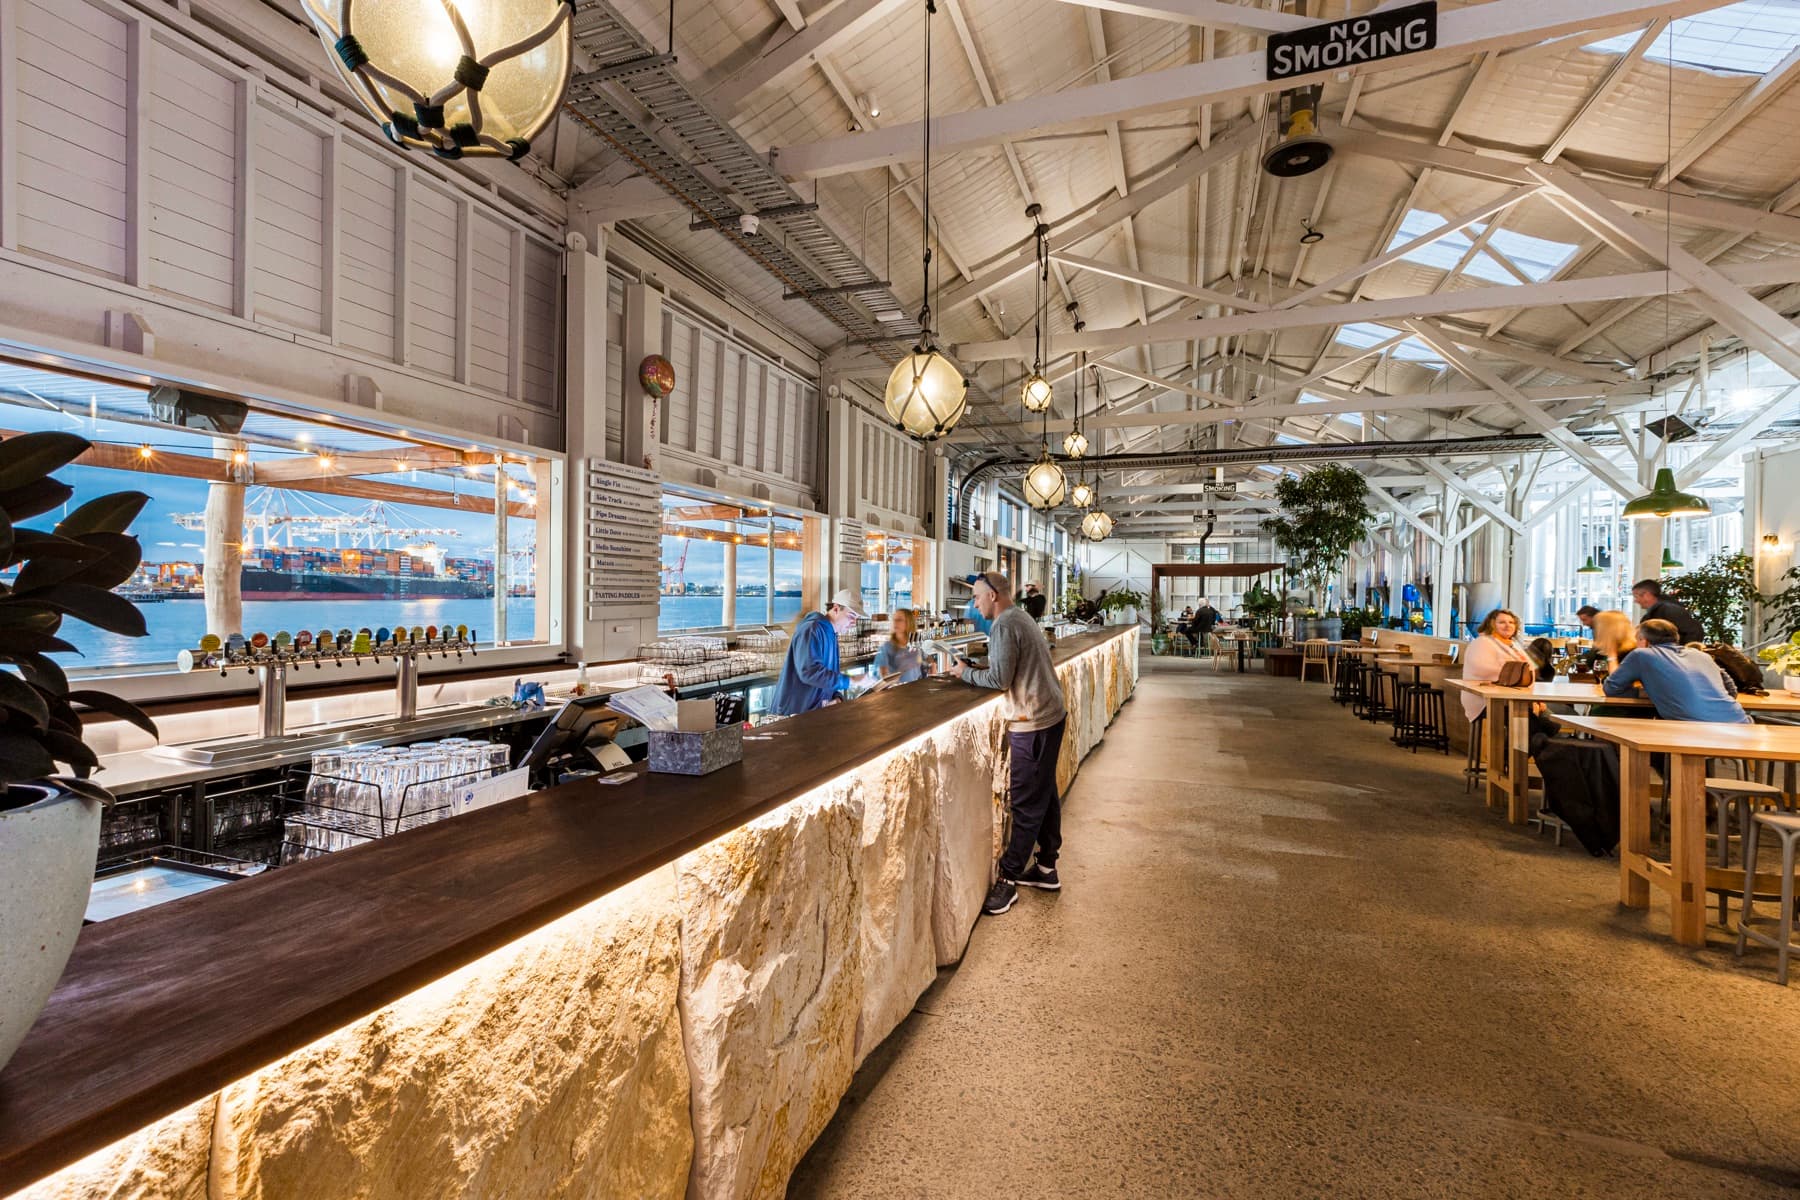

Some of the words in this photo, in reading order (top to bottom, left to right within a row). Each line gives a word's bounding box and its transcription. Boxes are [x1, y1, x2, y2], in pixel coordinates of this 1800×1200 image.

[1330, 19, 1371, 42] NO
[1272, 18, 1428, 75] SMOKING
[608, 496, 622, 504] Track
[608, 512, 627, 520] Dreams
[595, 527, 609, 535] Little
[595, 591, 617, 599] TASTING
